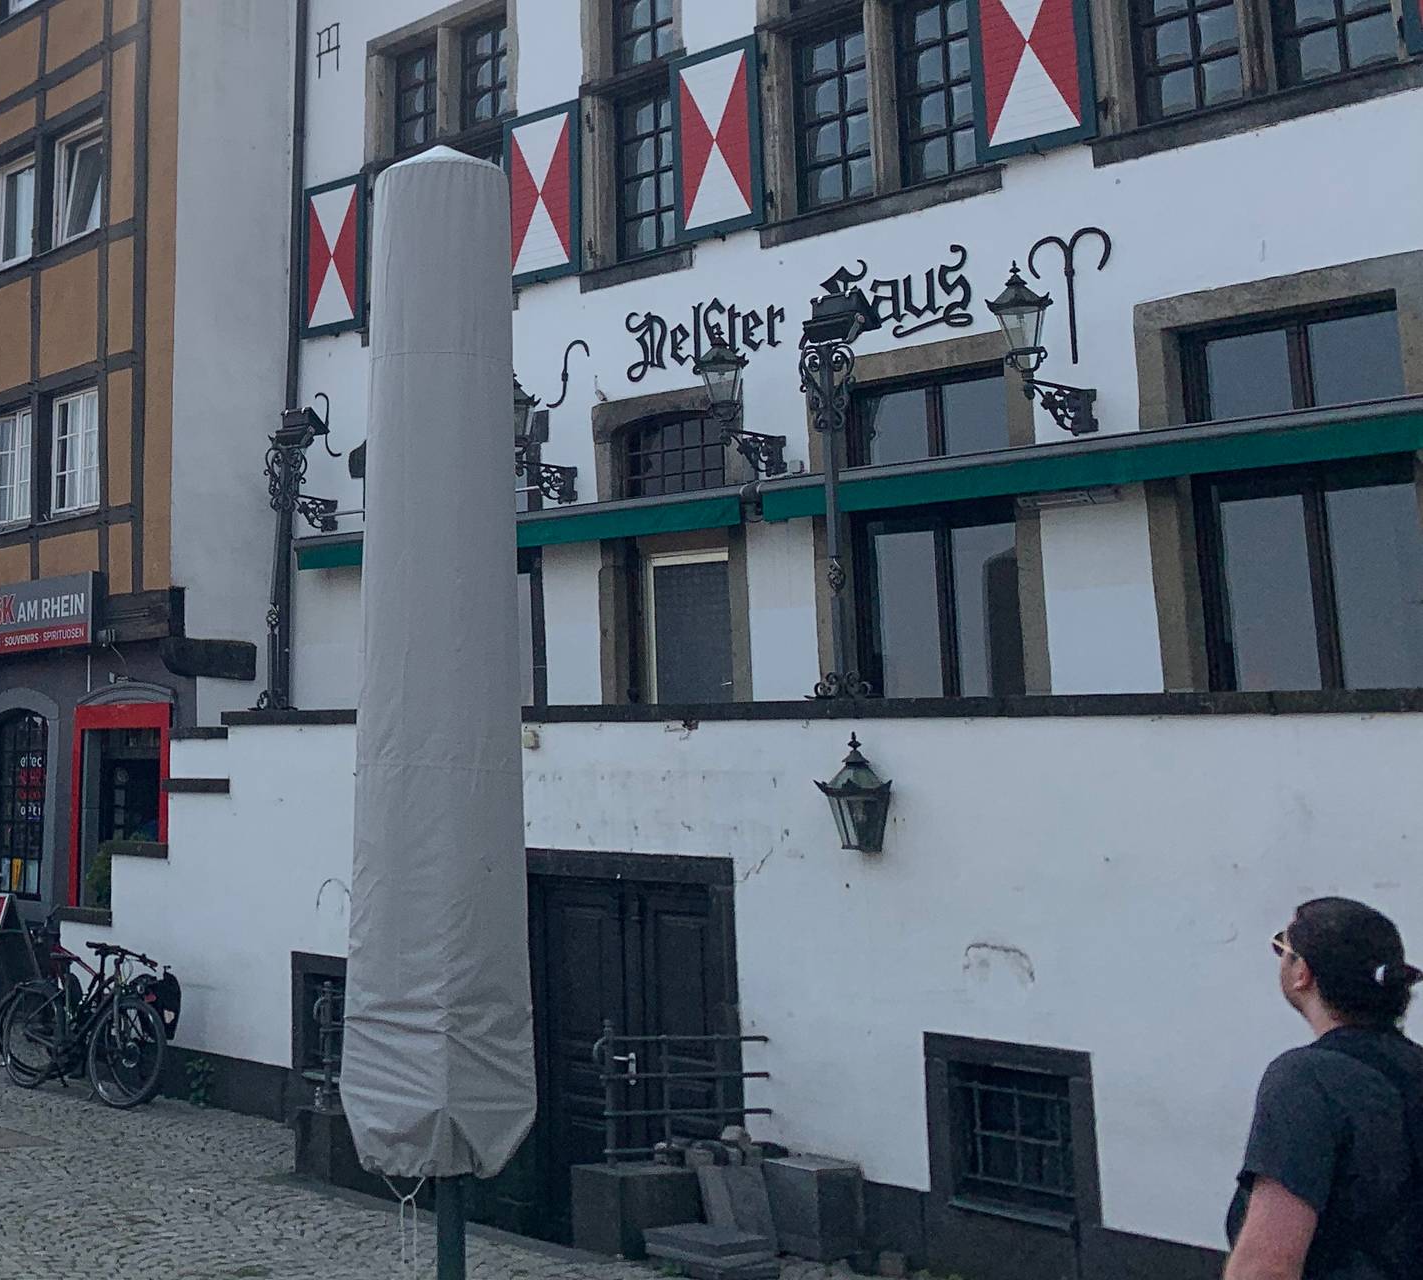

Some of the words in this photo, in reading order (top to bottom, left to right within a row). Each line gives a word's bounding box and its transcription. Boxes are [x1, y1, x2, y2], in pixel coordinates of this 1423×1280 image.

[17, 600, 37, 622] AM
[41, 593, 85, 619] RHEIN
[4, 632, 39, 647] SOUVENIRS
[42, 627, 85, 642] SPIRITUOSEN
